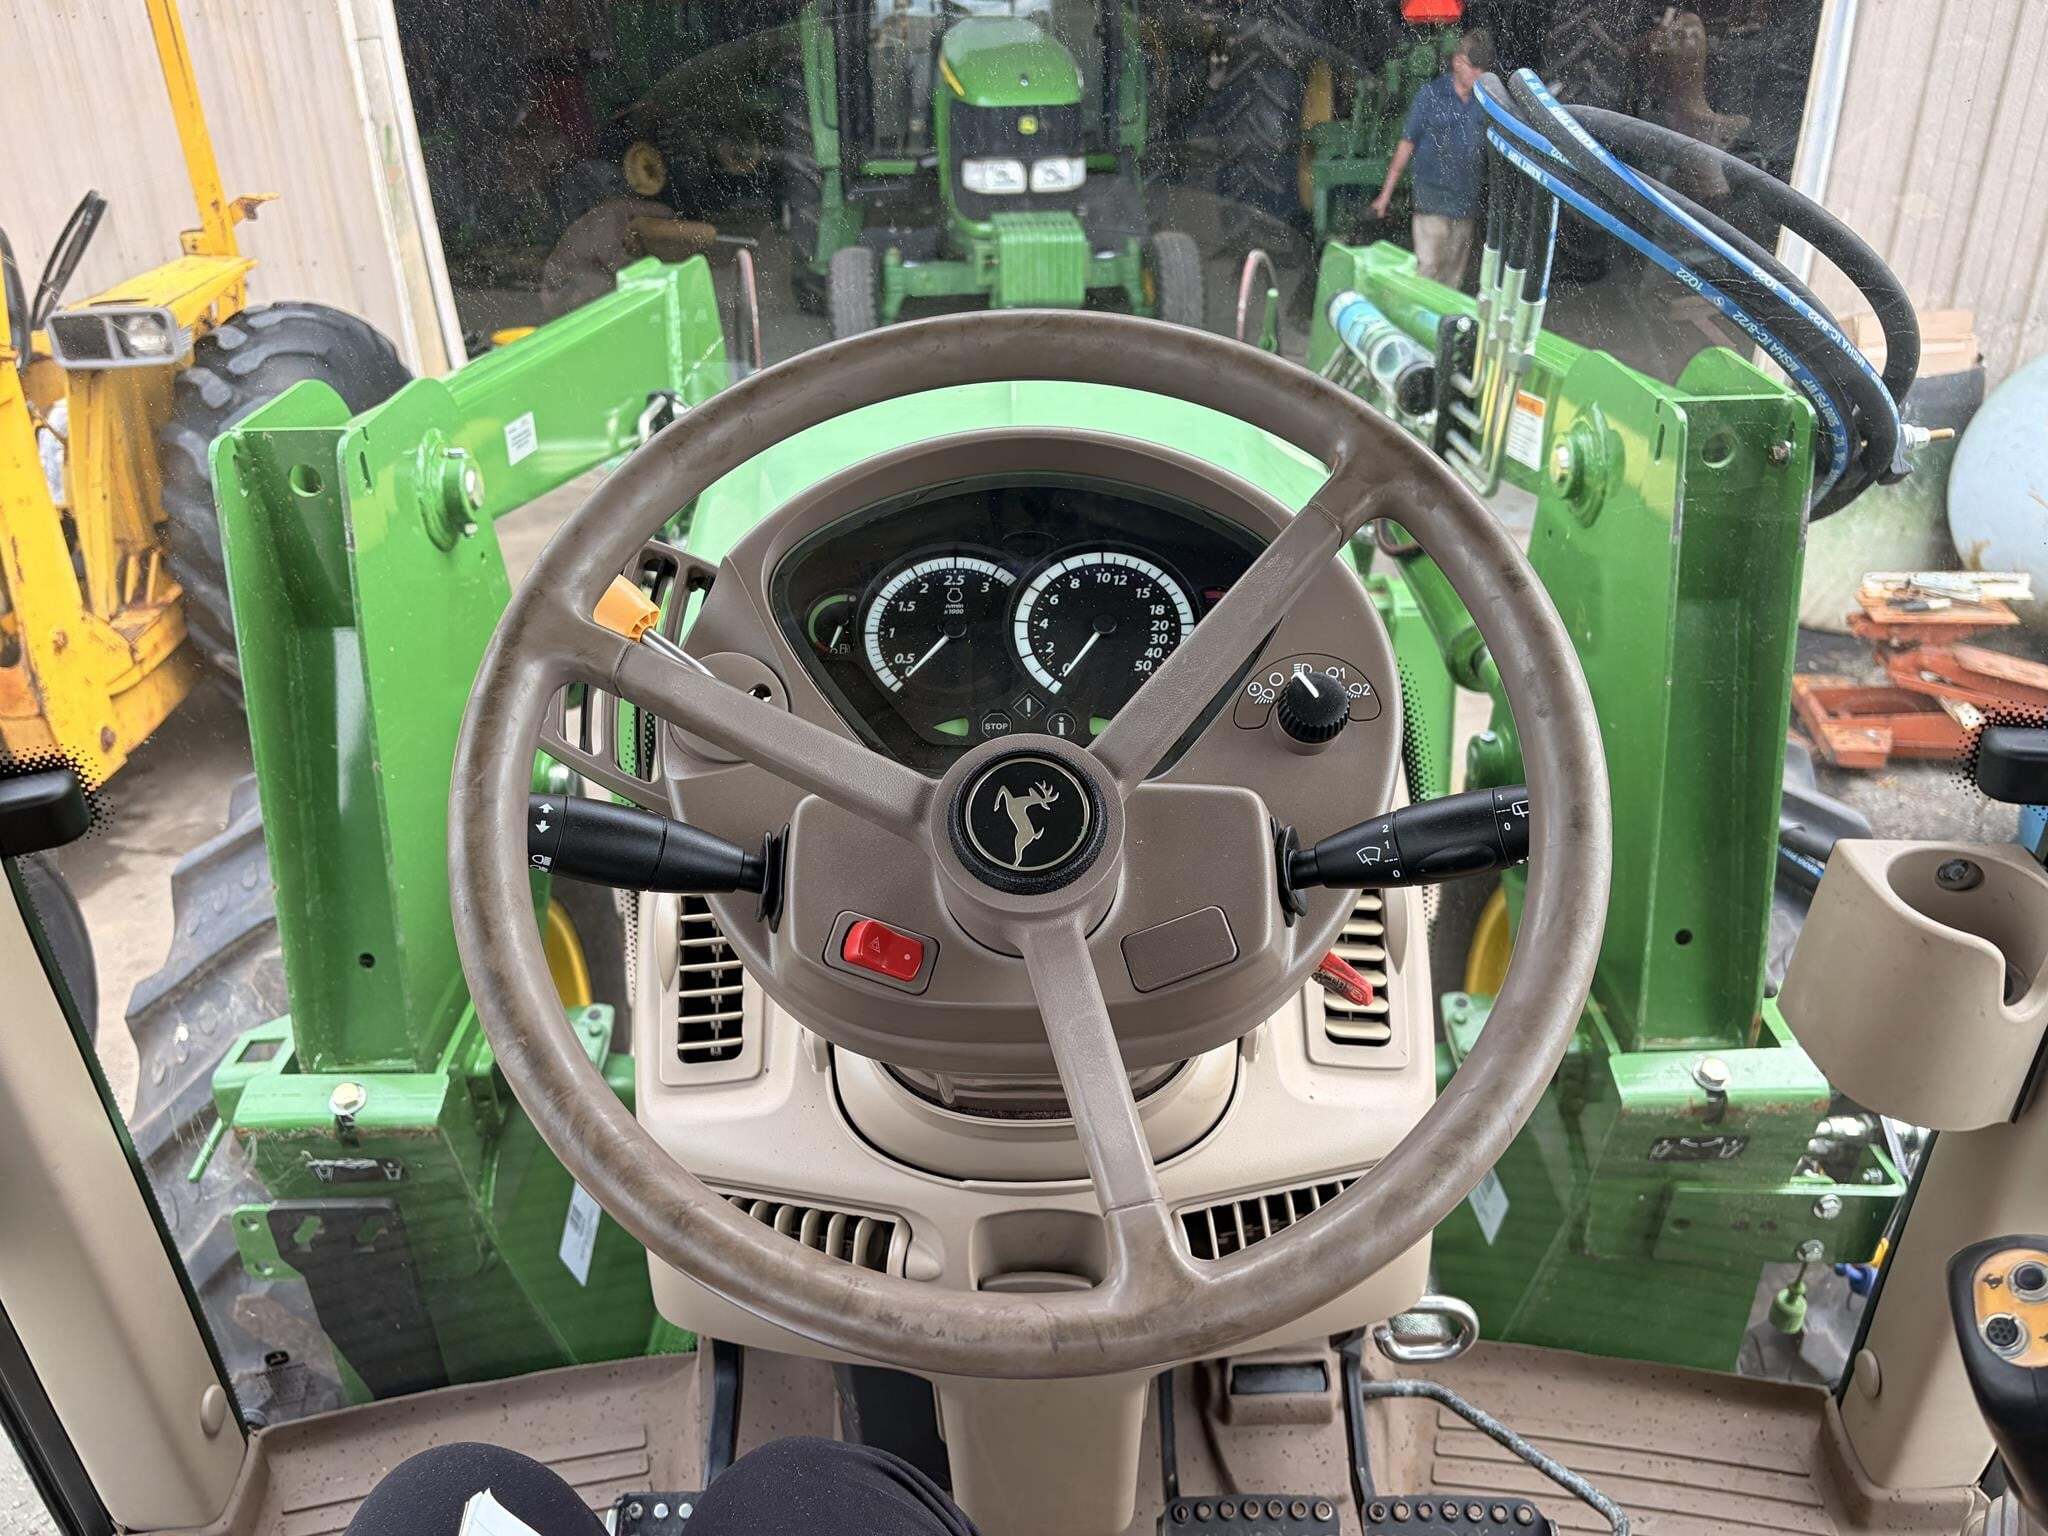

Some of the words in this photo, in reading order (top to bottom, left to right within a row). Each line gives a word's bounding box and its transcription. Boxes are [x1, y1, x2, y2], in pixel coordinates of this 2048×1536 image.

[1731, 310, 1773, 347] IC-8/22
[1768, 342, 1801, 373] MSHA
[943, 575, 965, 586] 2.5
[1096, 572, 1111, 583] 10
[1113, 574, 1128, 586] 12
[919, 583, 929, 594] 2
[980, 582, 990, 593] 3
[1070, 578, 1080, 589] 8
[1136, 587, 1151, 599] 15
[1049, 594, 1059, 605] 6
[898, 601, 916, 612] 1.5
[1149, 604, 1165, 615] 18
[1039, 618, 1049, 629] 4
[1150, 620, 1169, 631] 20
[888, 627, 896, 639] 1
[1149, 634, 1168, 645] 30
[1045, 642, 1055, 653] 2
[1144, 647, 1163, 658] 40
[894, 653, 915, 664] 0.5
[904, 665, 914, 676] 0
[1062, 662, 1071, 673] 0
[1134, 660, 1152, 671] 50
[1339, 667, 1346, 679] 1
[1362, 684, 1371, 696] 2
[984, 722, 1008, 730] STOP
[1382, 824, 1389, 833] 2
[1504, 822, 1511, 831] 0
[1384, 839, 1390, 849] 1
[1392, 869, 1401, 878] 0
